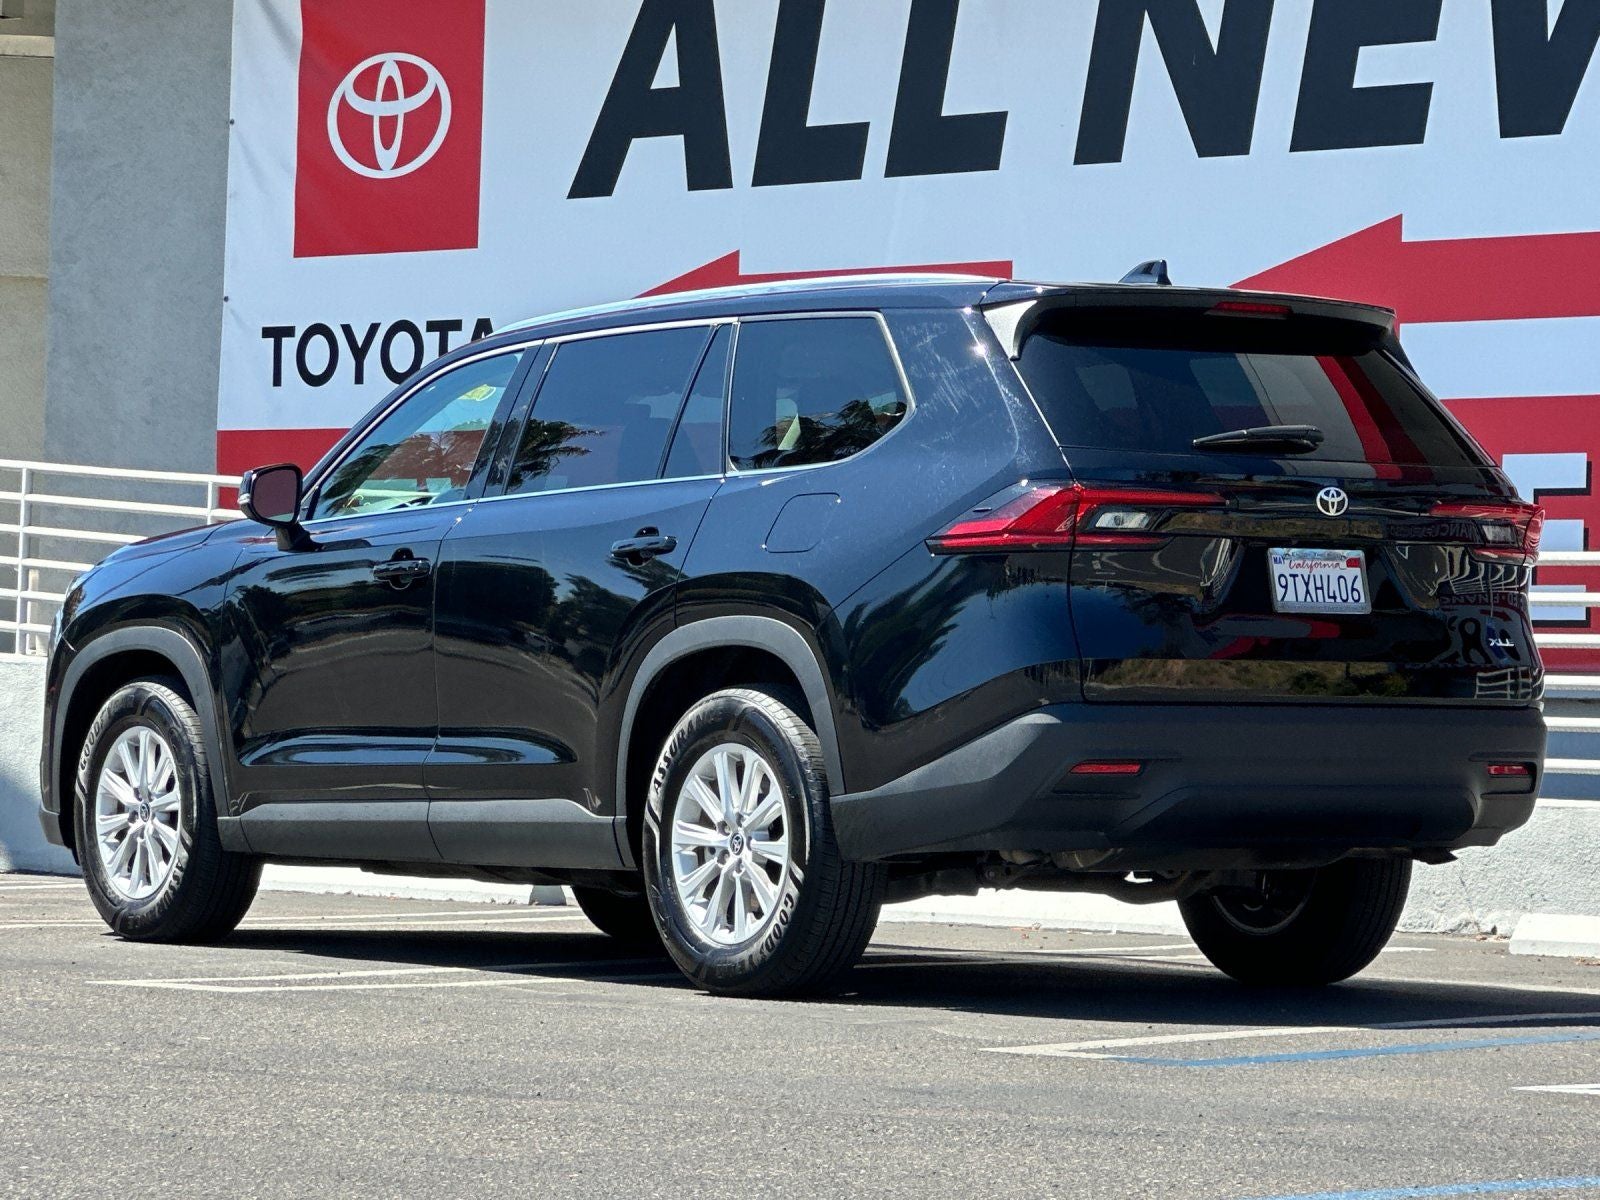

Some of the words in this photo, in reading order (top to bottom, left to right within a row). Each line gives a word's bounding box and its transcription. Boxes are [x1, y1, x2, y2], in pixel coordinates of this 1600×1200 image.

[567, 0, 1008, 199] ALL
[1073, 0, 1600, 164] NE
[1288, 559, 1341, 573] California
[1277, 573, 1361, 603] 9TXH406
